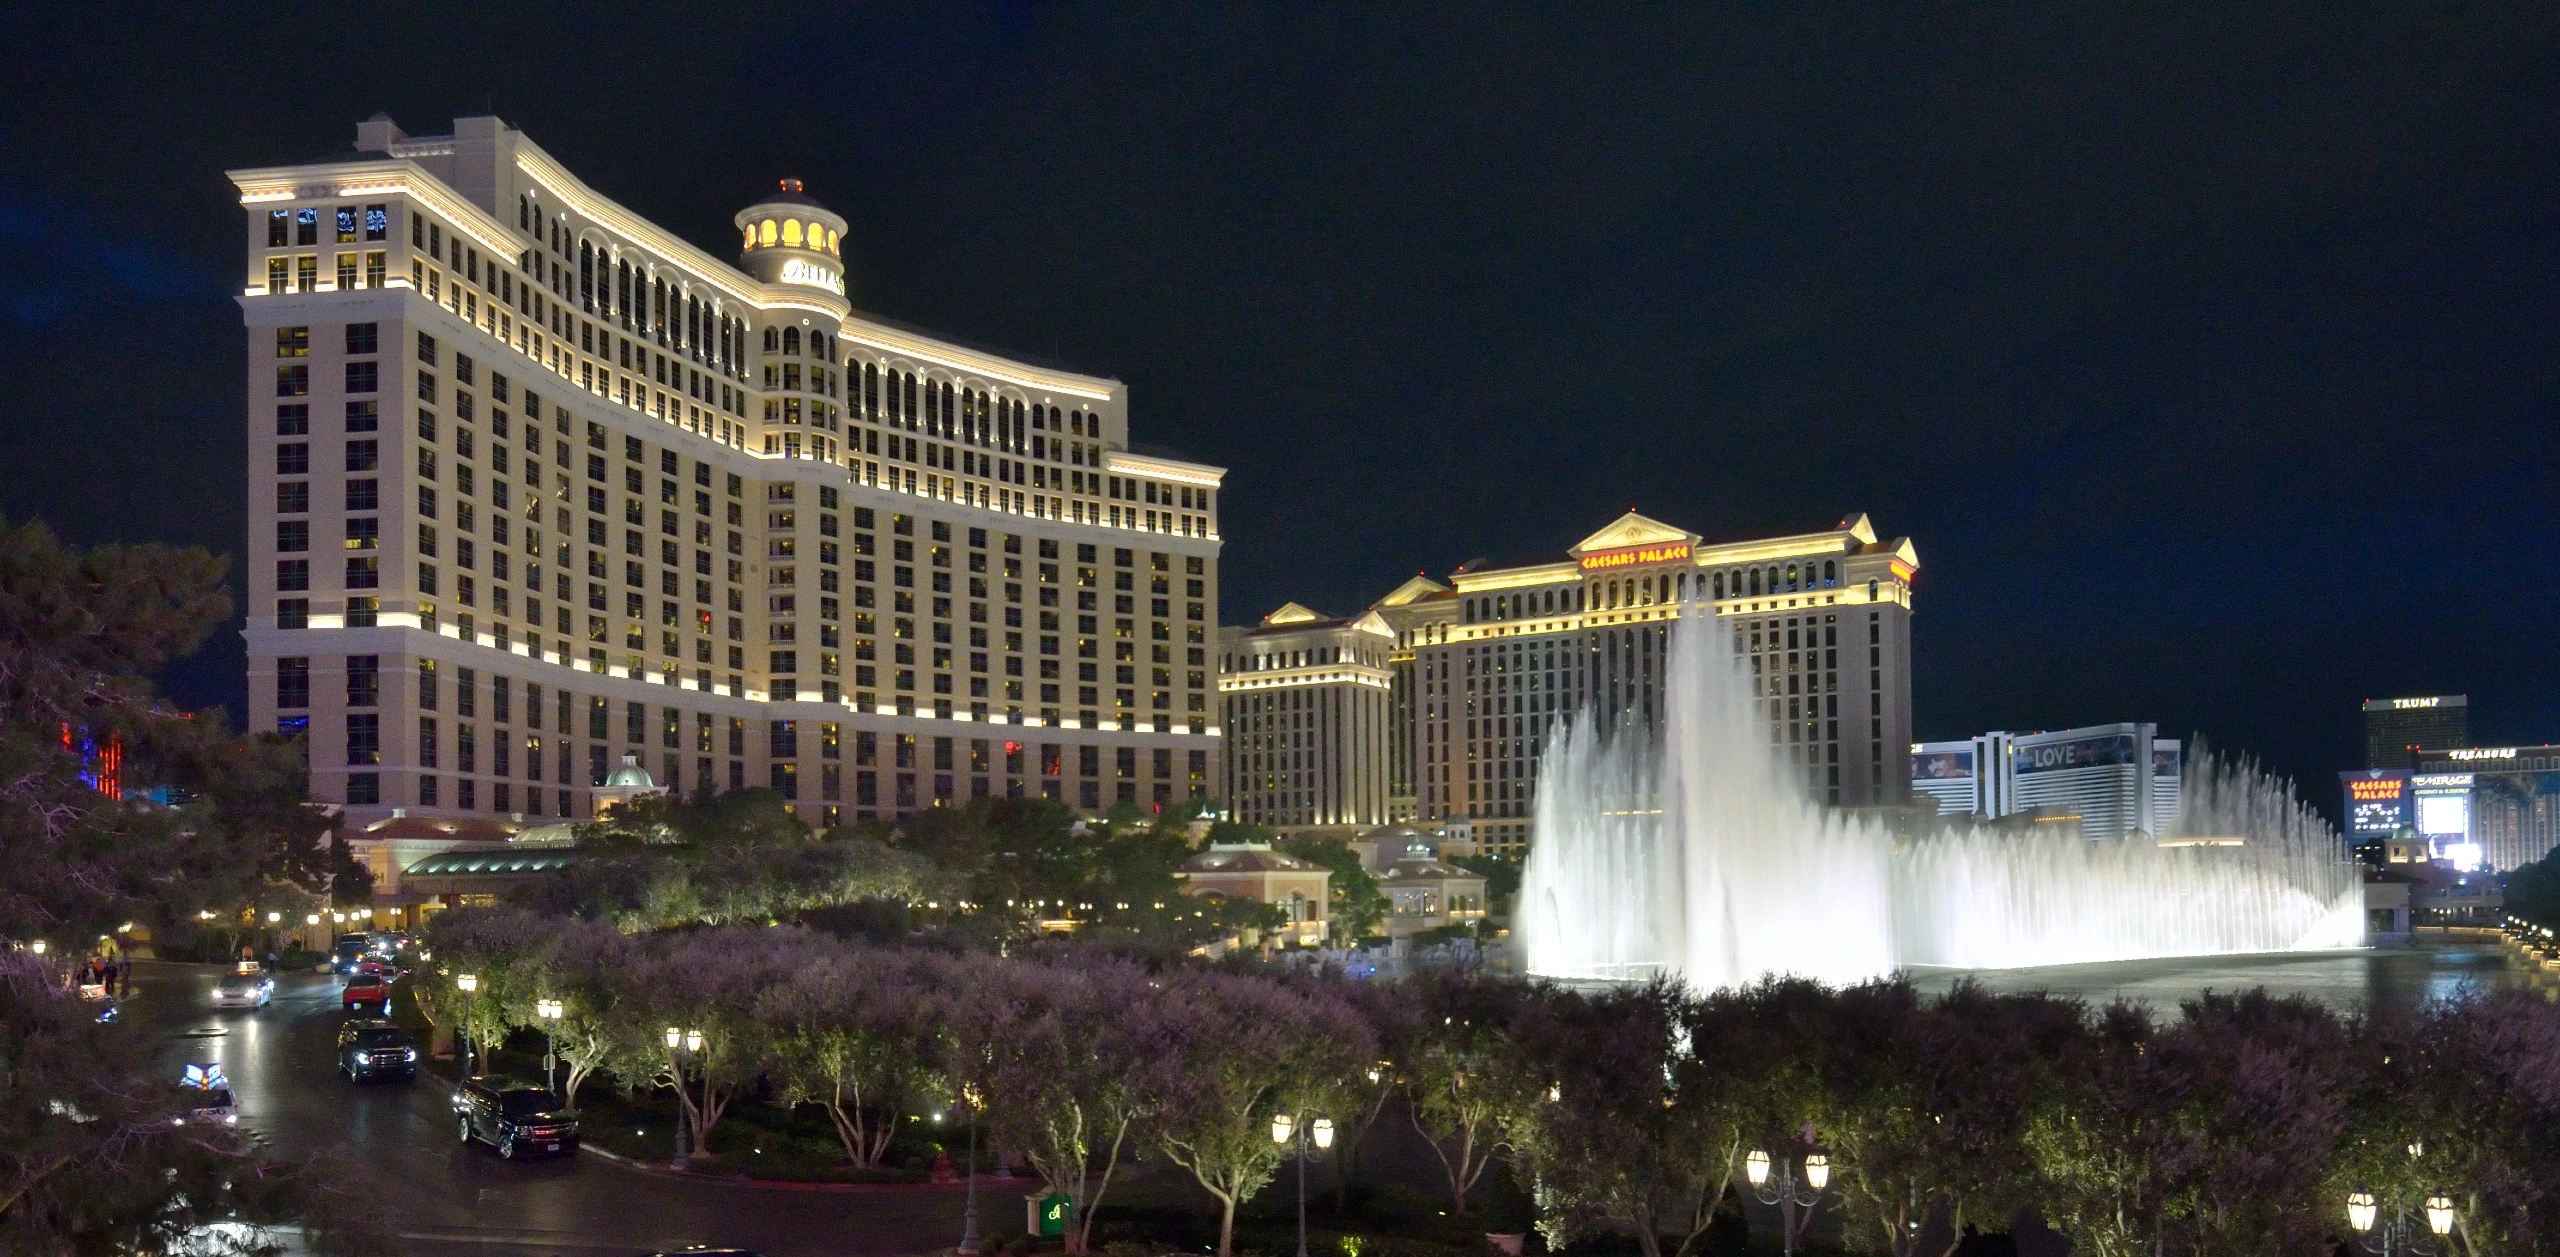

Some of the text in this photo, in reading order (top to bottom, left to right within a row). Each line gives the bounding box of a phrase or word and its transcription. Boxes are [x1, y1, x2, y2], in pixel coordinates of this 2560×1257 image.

[1582, 546, 1688, 569] CAESARS PALACE
[2393, 697, 2439, 709] TRUMP
[2035, 745, 2075, 767] LOVE
[2449, 748, 2516, 760] TREASURE
[2351, 780, 2401, 790] CAESARS
[2417, 775, 2472, 786] MIRAGE
[2354, 790, 2399, 799] PALACE
